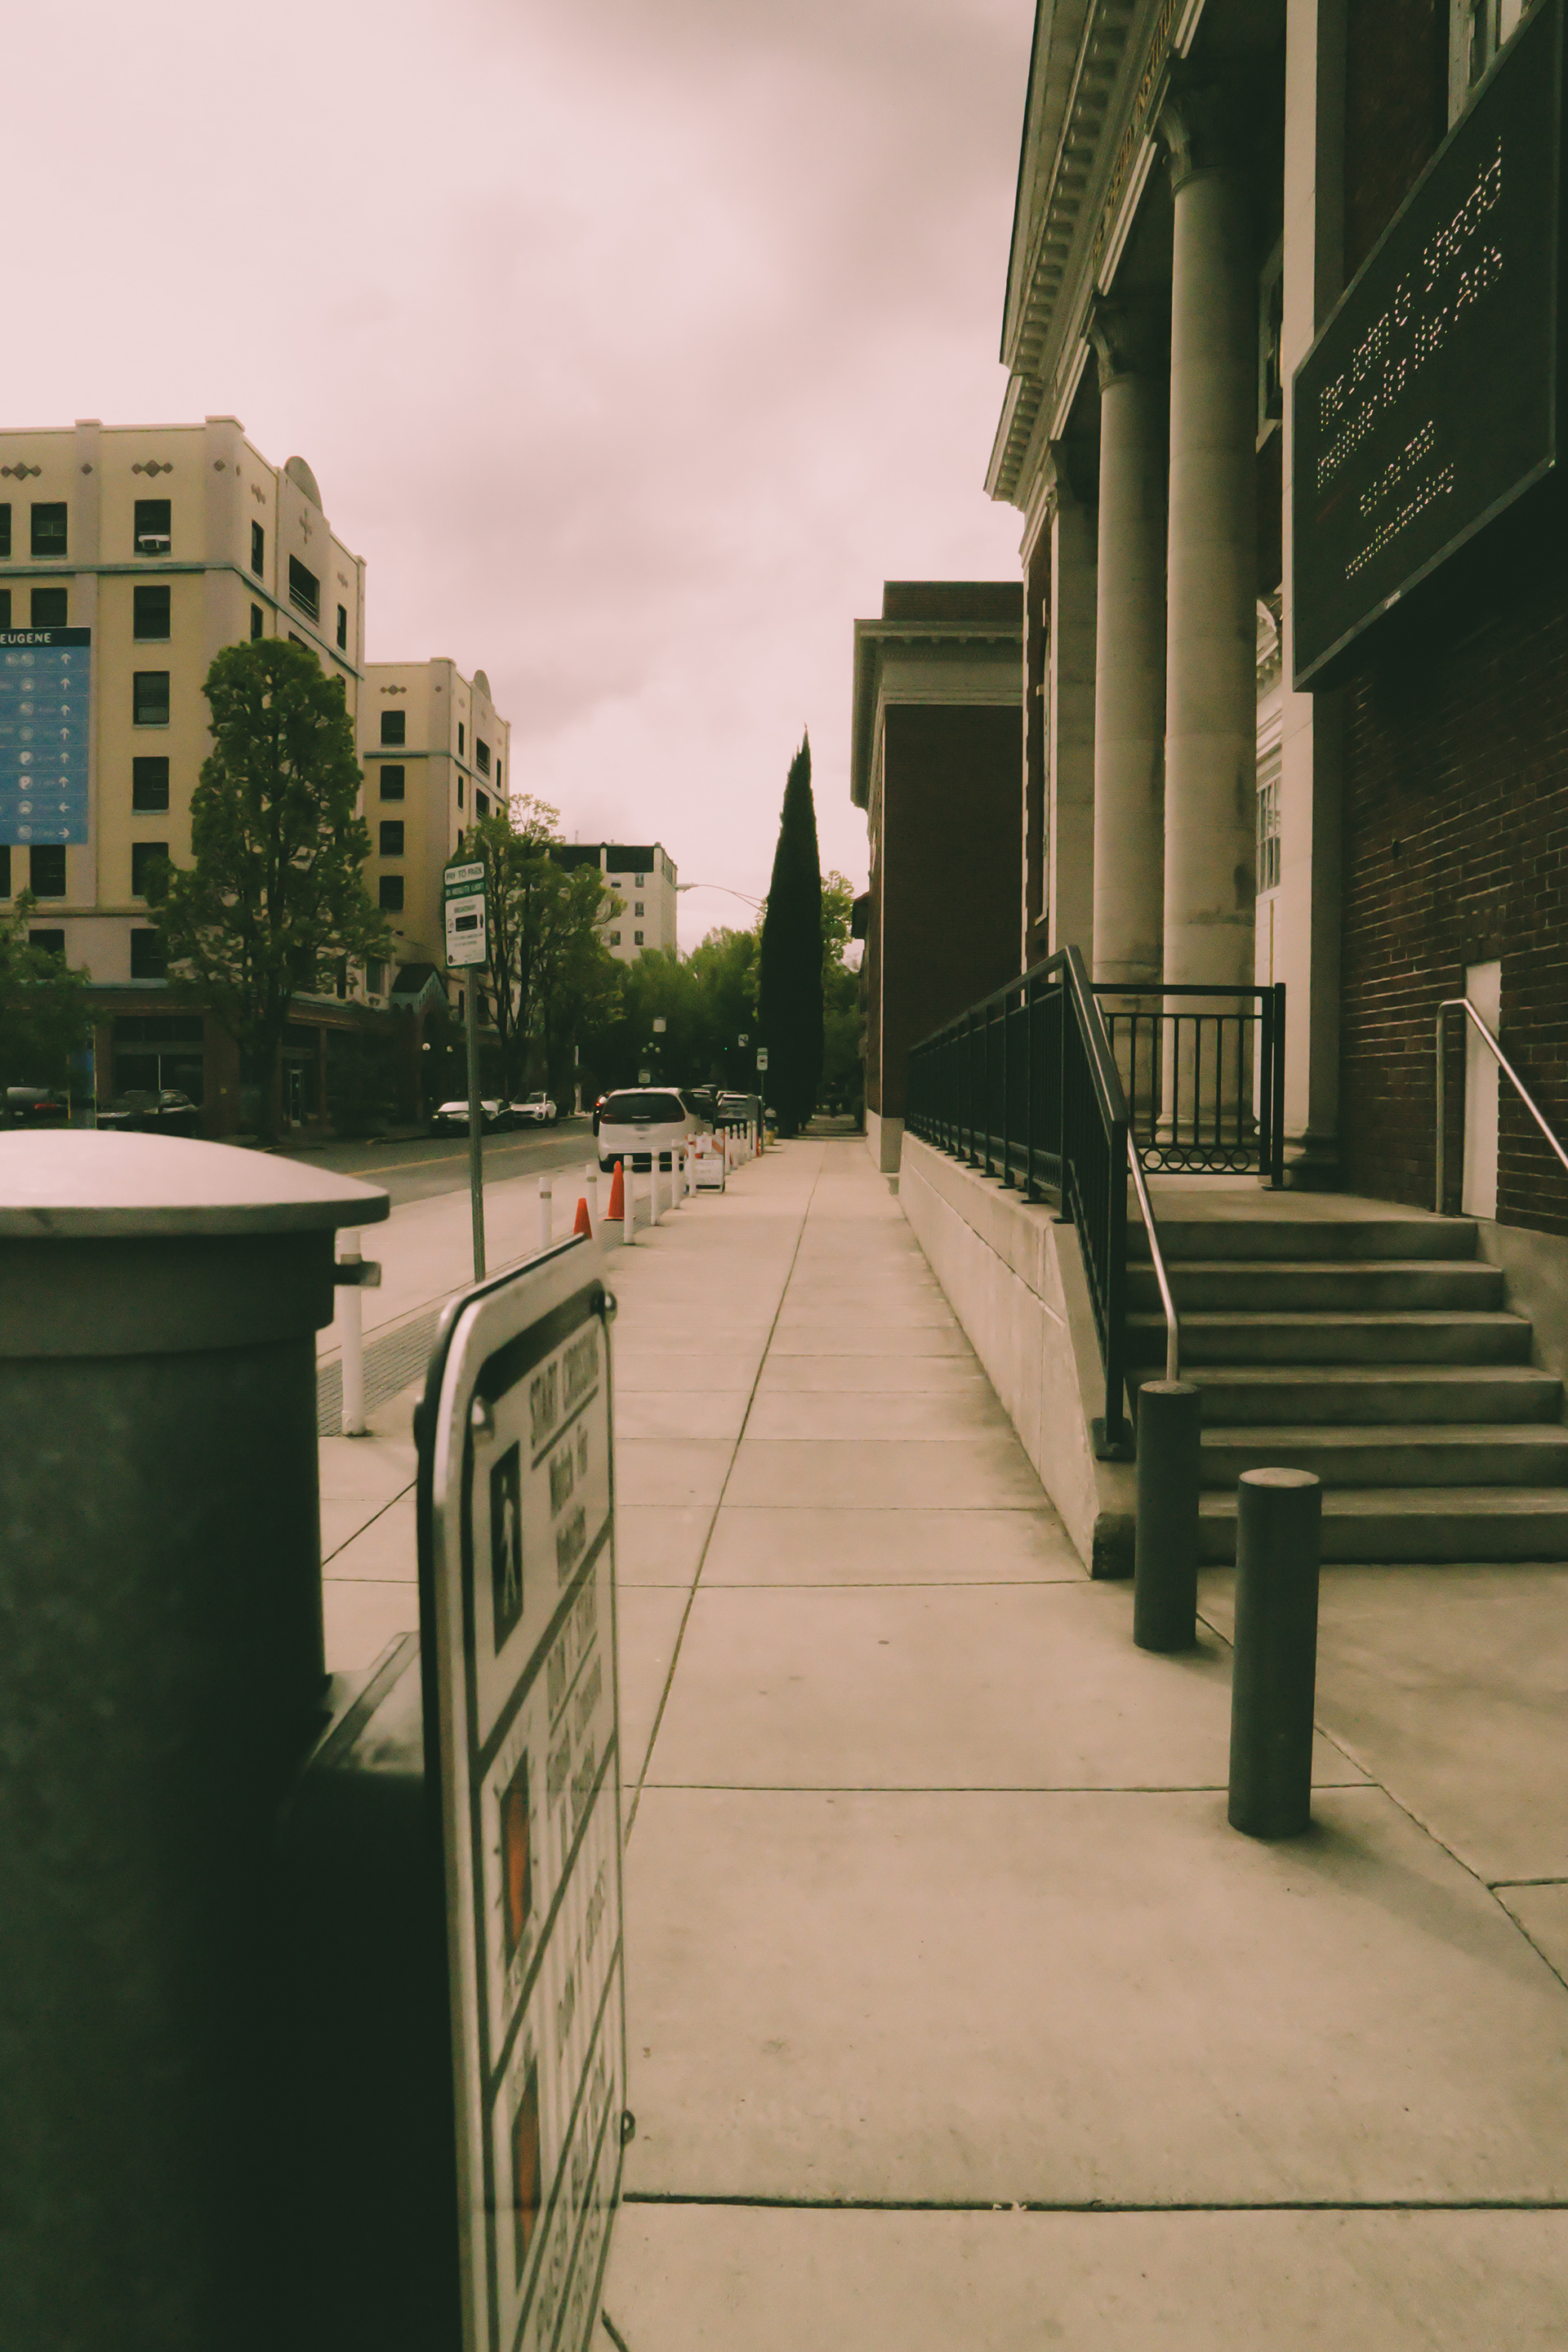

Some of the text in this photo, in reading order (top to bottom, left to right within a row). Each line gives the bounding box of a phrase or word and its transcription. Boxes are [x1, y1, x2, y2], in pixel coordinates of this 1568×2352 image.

[1320, 374, 1344, 432] The
[1348, 312, 1389, 395] John
[1423, 136, 1502, 292] Shedd
[1317, 245, 1503, 493] Institute for the Arts
[0, 633, 51, 644] EUGENE
[457, 868, 466, 878] TO
